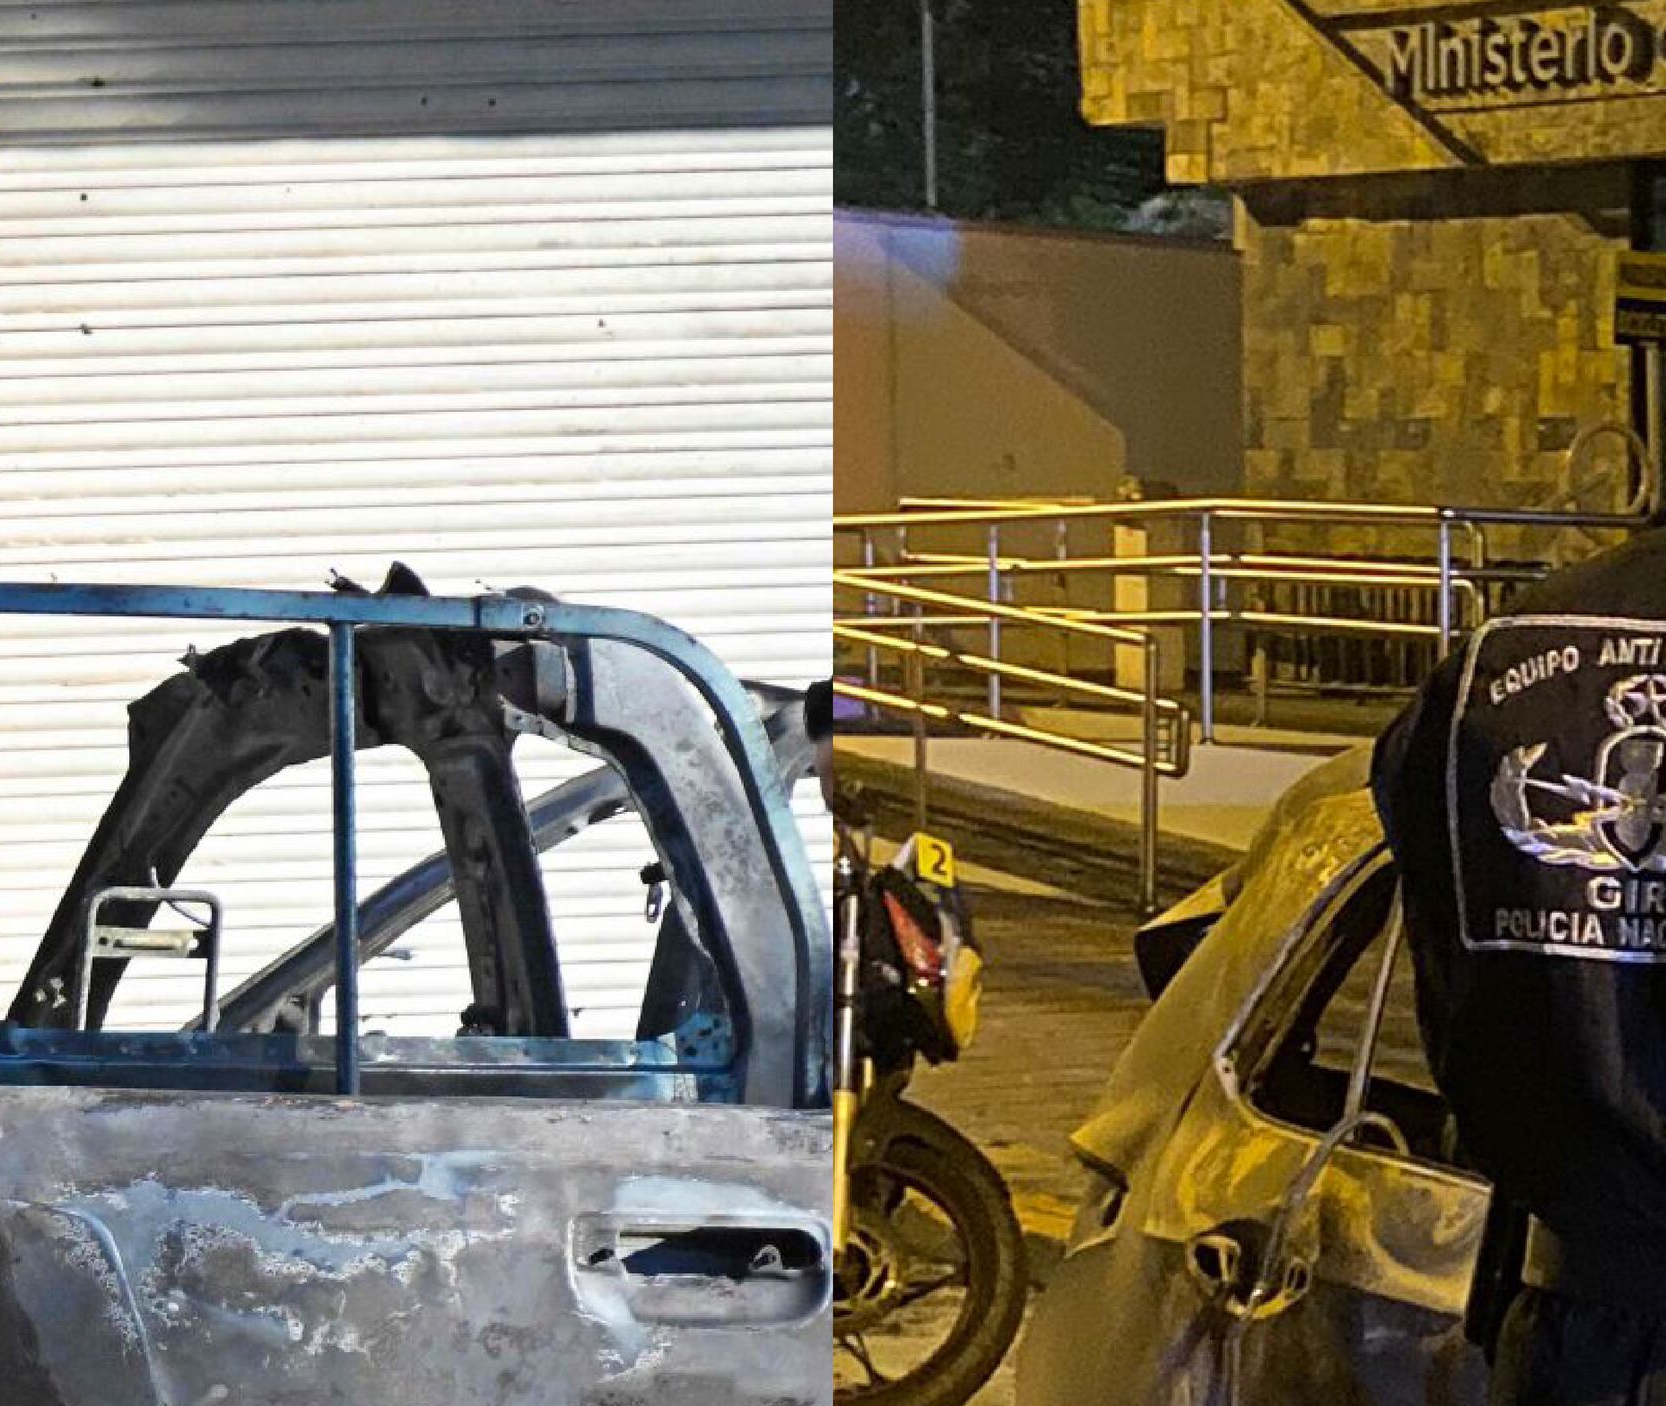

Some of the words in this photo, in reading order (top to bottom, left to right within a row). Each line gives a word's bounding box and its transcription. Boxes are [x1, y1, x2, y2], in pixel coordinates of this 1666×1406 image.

[1385, 7, 1634, 98] Ministerio
[1489, 645, 1580, 705] EQUIPO
[1597, 637, 1663, 668] ANTI
[931, 842, 948, 876] 2
[1587, 875, 1666, 914] GIR
[1494, 906, 1605, 945] POLICIA
